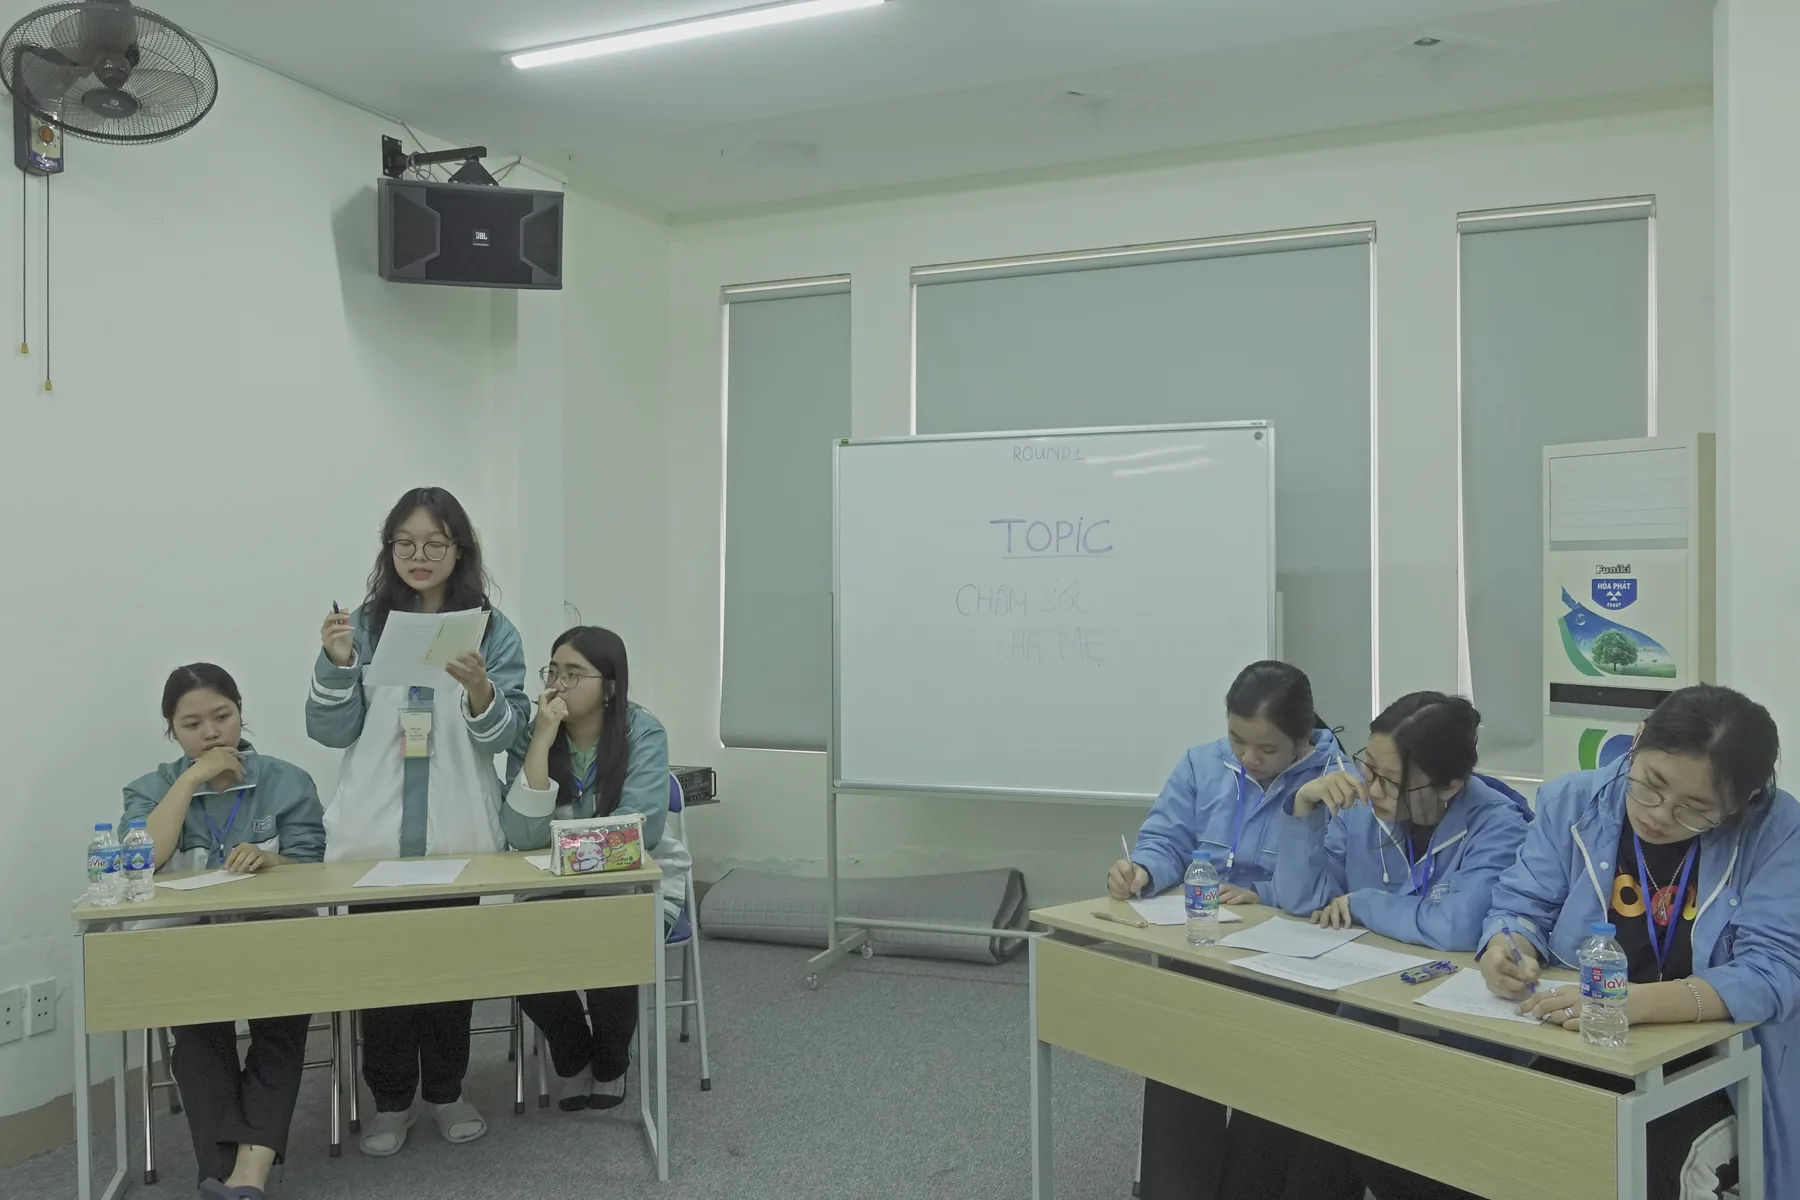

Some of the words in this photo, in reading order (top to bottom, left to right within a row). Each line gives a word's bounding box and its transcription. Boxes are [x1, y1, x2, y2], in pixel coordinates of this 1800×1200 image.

[475, 231, 488, 240] JBL
[1596, 564, 1631, 574] Funiki
[1612, 580, 1631, 590] PHÁT
